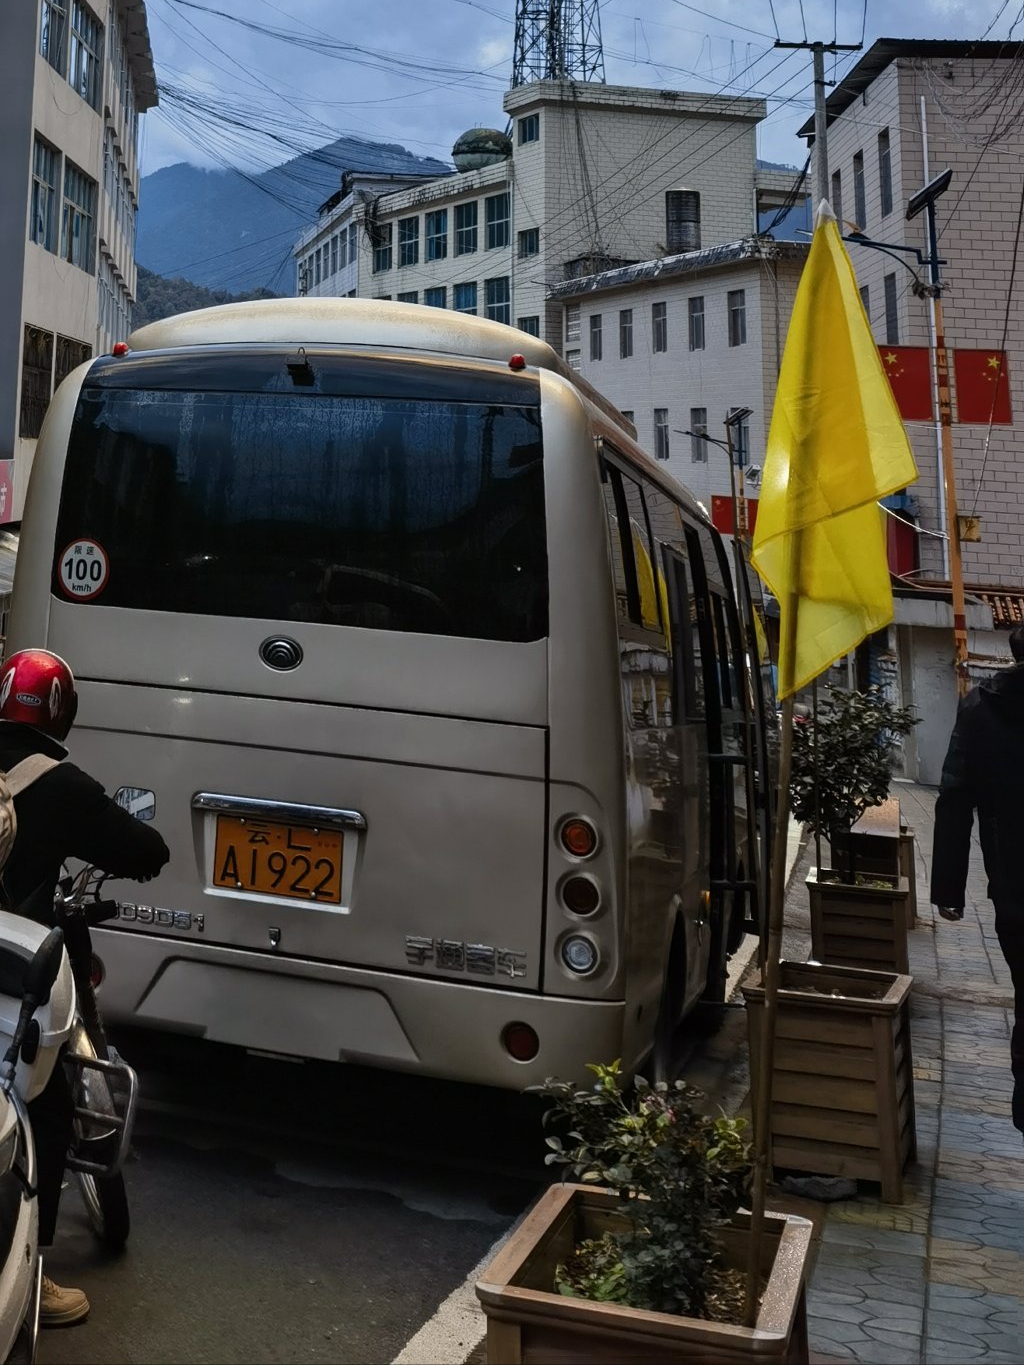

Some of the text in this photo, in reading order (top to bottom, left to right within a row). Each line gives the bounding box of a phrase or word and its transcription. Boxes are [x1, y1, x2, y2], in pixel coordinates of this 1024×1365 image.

[74, 545, 95, 556] 限速
[64, 557, 102, 582] 100
[72, 583, 92, 592] km/h
[220, 845, 335, 898] A1922
